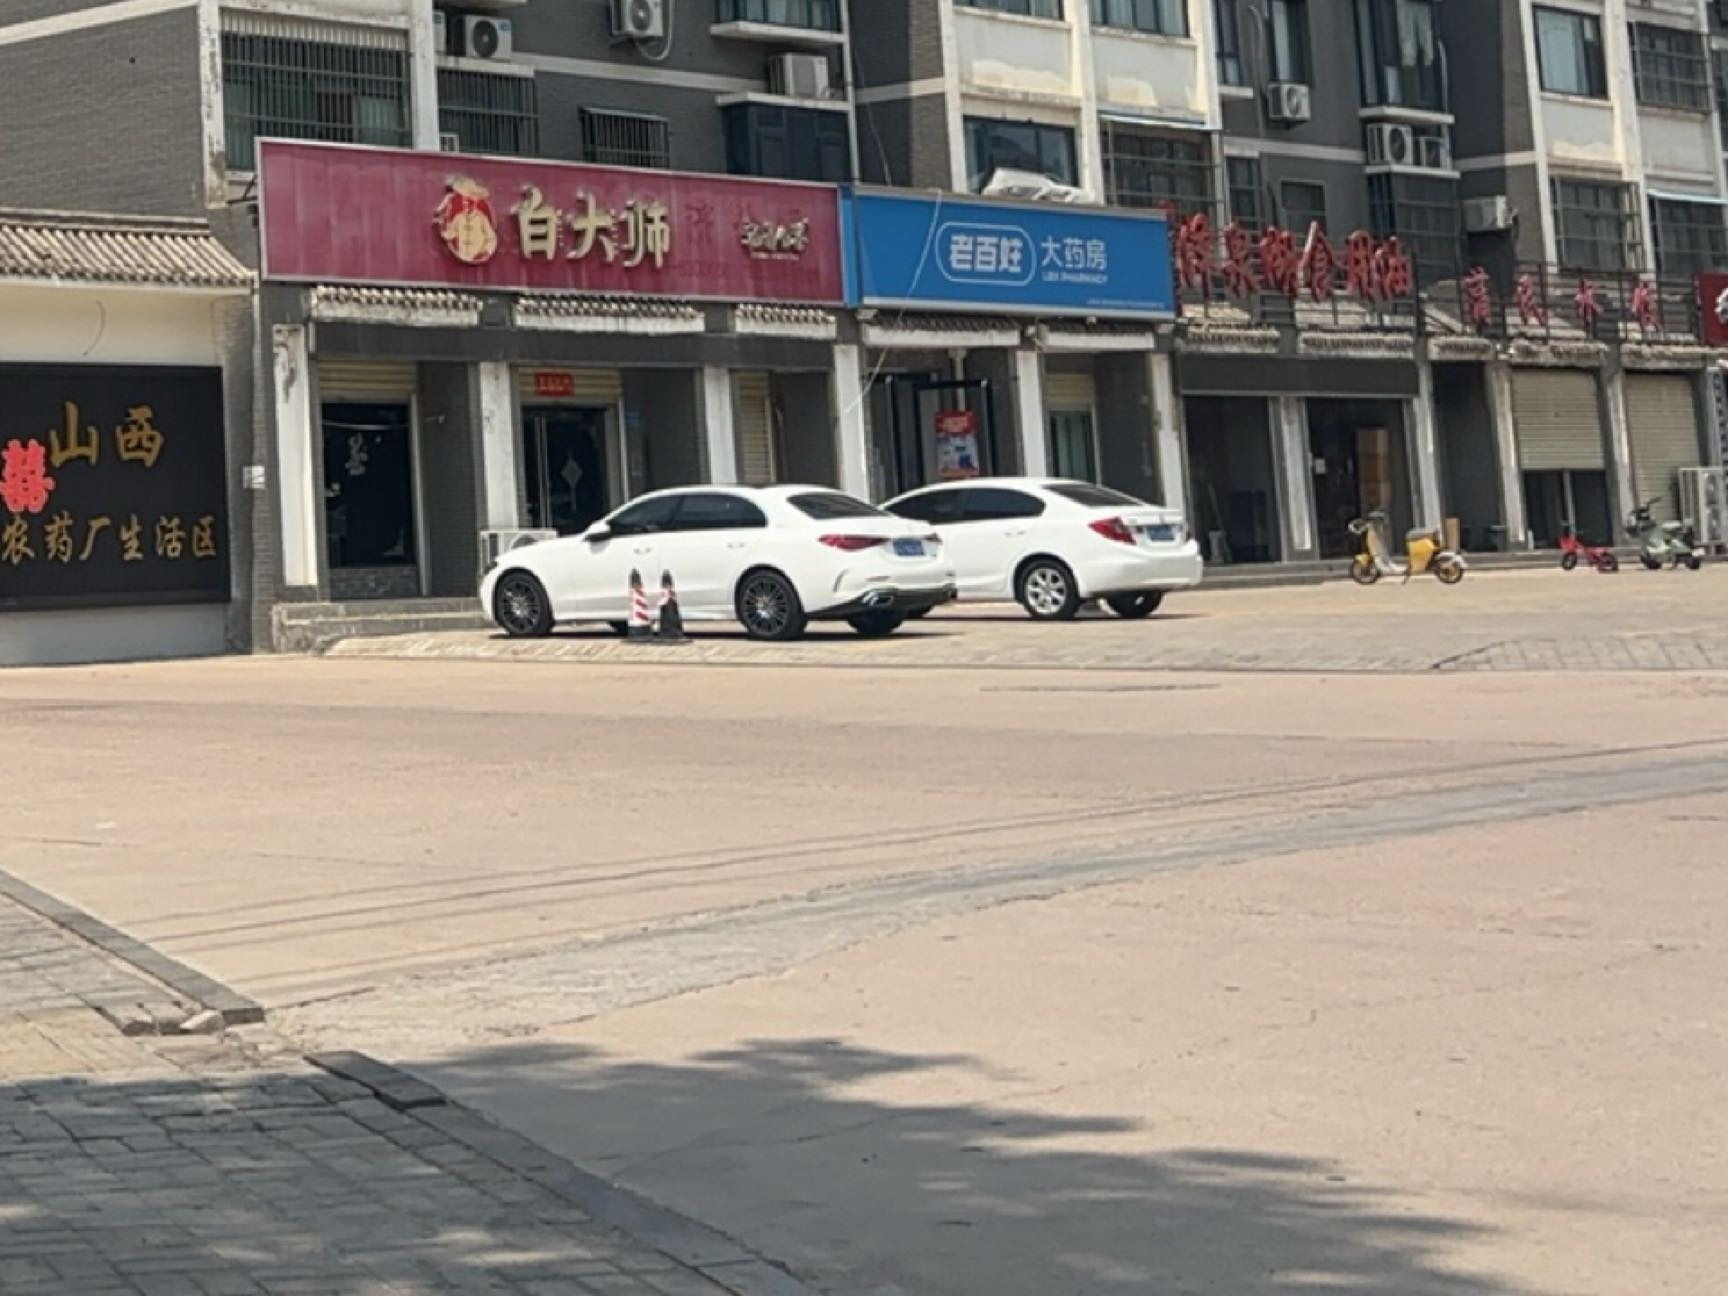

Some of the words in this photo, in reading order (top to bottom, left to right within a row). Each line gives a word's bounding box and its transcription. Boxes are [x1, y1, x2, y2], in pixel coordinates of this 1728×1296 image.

[949, 234, 1022, 272] 老百姓
[1040, 236, 1107, 270] 大药房
[50, 401, 164, 467] 山西
[2, 511, 216, 565] 农药厂生活区
